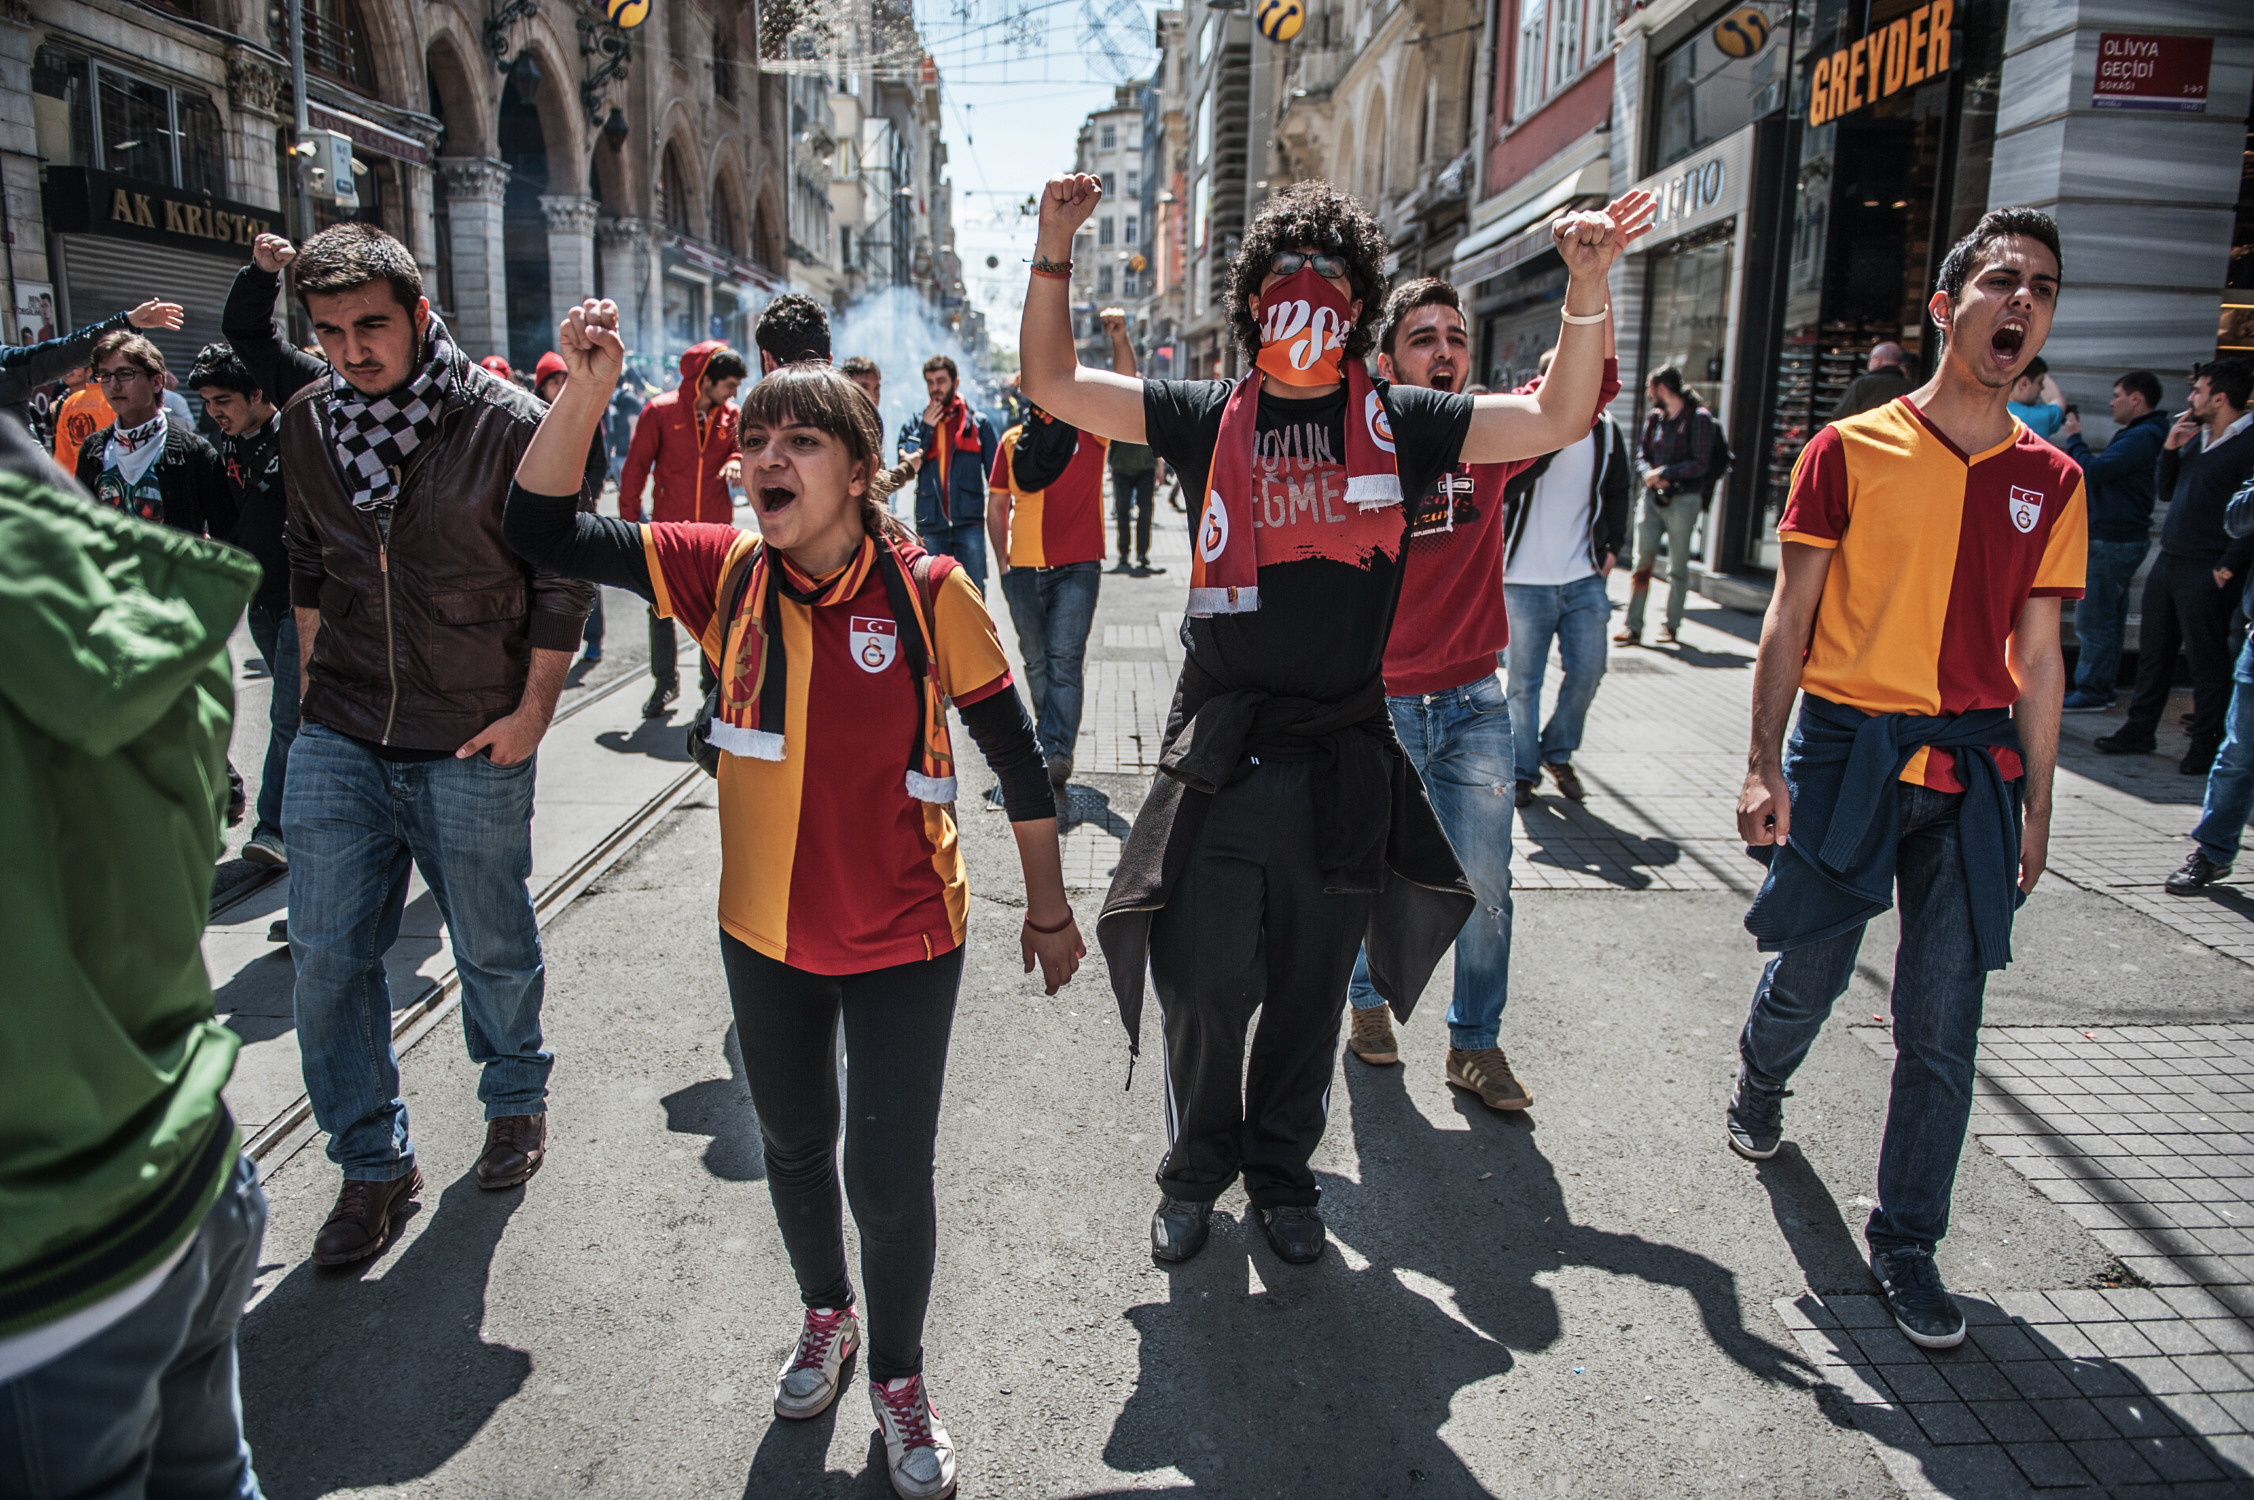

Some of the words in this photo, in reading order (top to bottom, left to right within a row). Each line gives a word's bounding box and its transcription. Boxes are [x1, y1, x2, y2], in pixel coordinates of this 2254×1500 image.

[2104, 38, 2159, 57] OLİVYA
[1810, 0, 1955, 127] GREYDER
[2101, 59, 2155, 79] GEÇİDİ
[112, 188, 155, 229] AK
